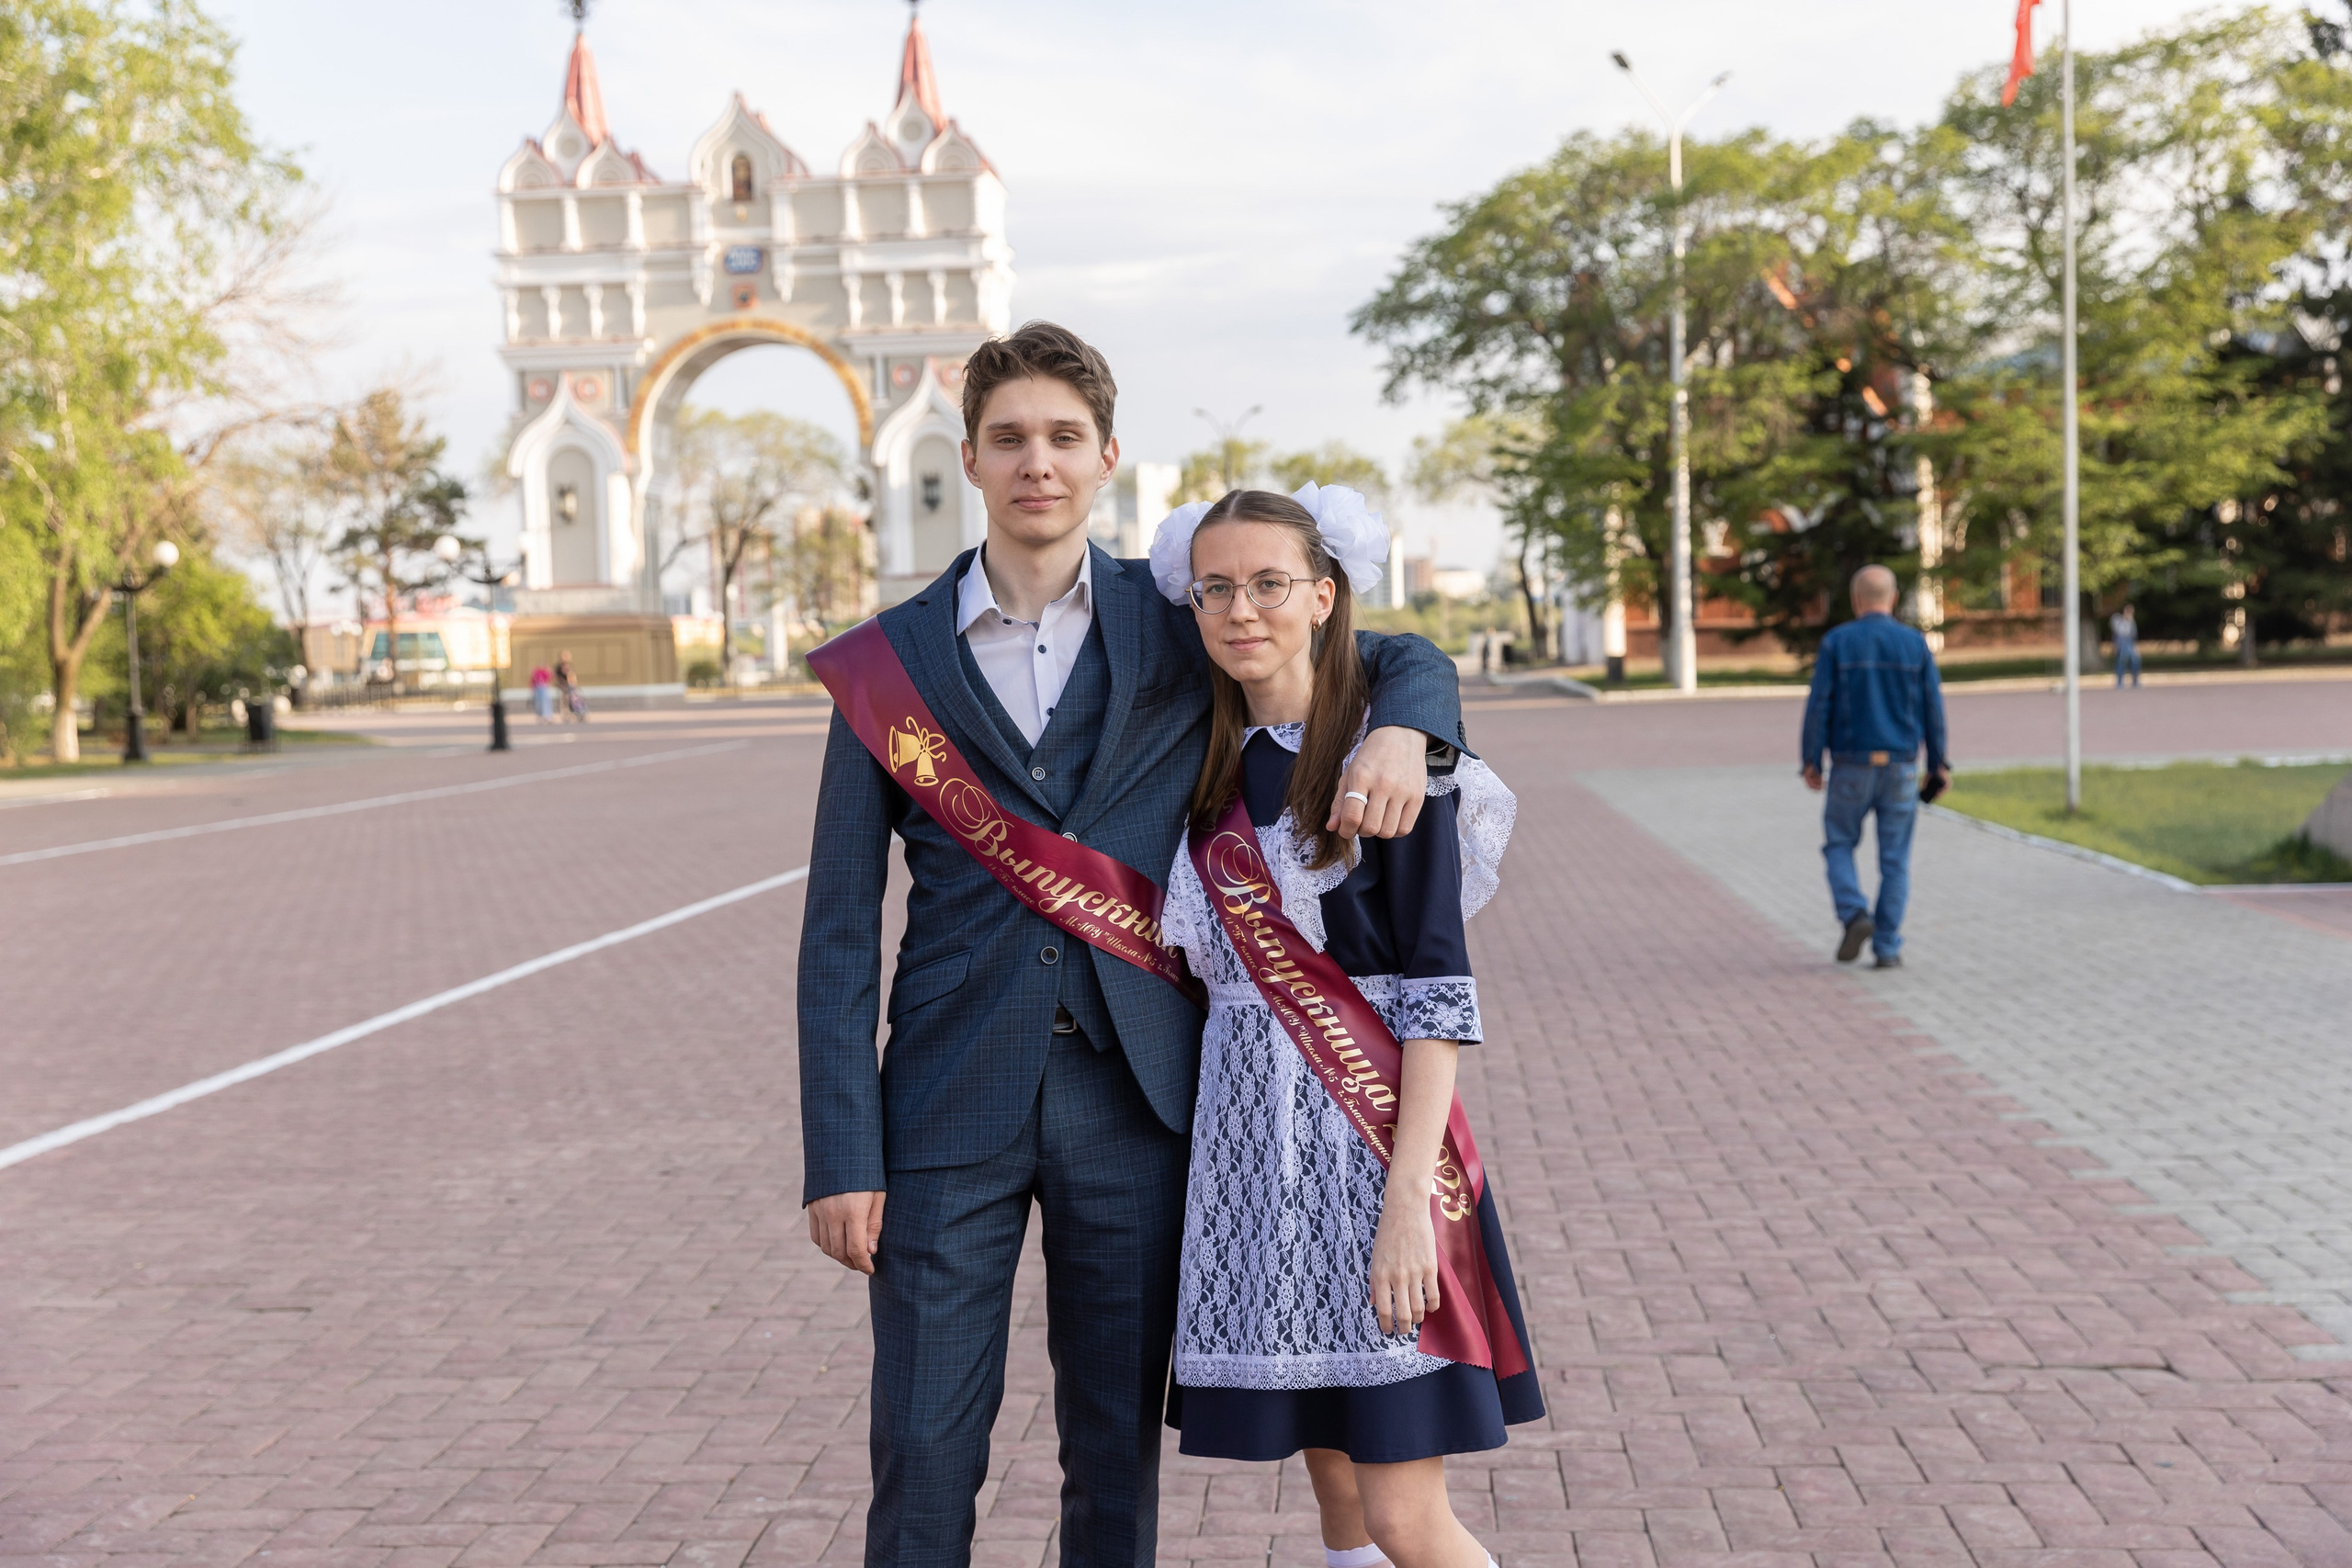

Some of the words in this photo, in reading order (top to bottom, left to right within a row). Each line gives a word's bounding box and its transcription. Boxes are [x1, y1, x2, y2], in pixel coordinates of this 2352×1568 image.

[1012, 885, 1035, 906] класс
[1059, 915, 1104, 939] МАОУ
[1137, 952, 1158, 966] №5
[1206, 830, 1397, 1111] Выпускница
[1240, 945, 1258, 970] класс
[1269, 991, 1302, 1026] МАОУ
[1319, 1064, 1340, 1083] №5
